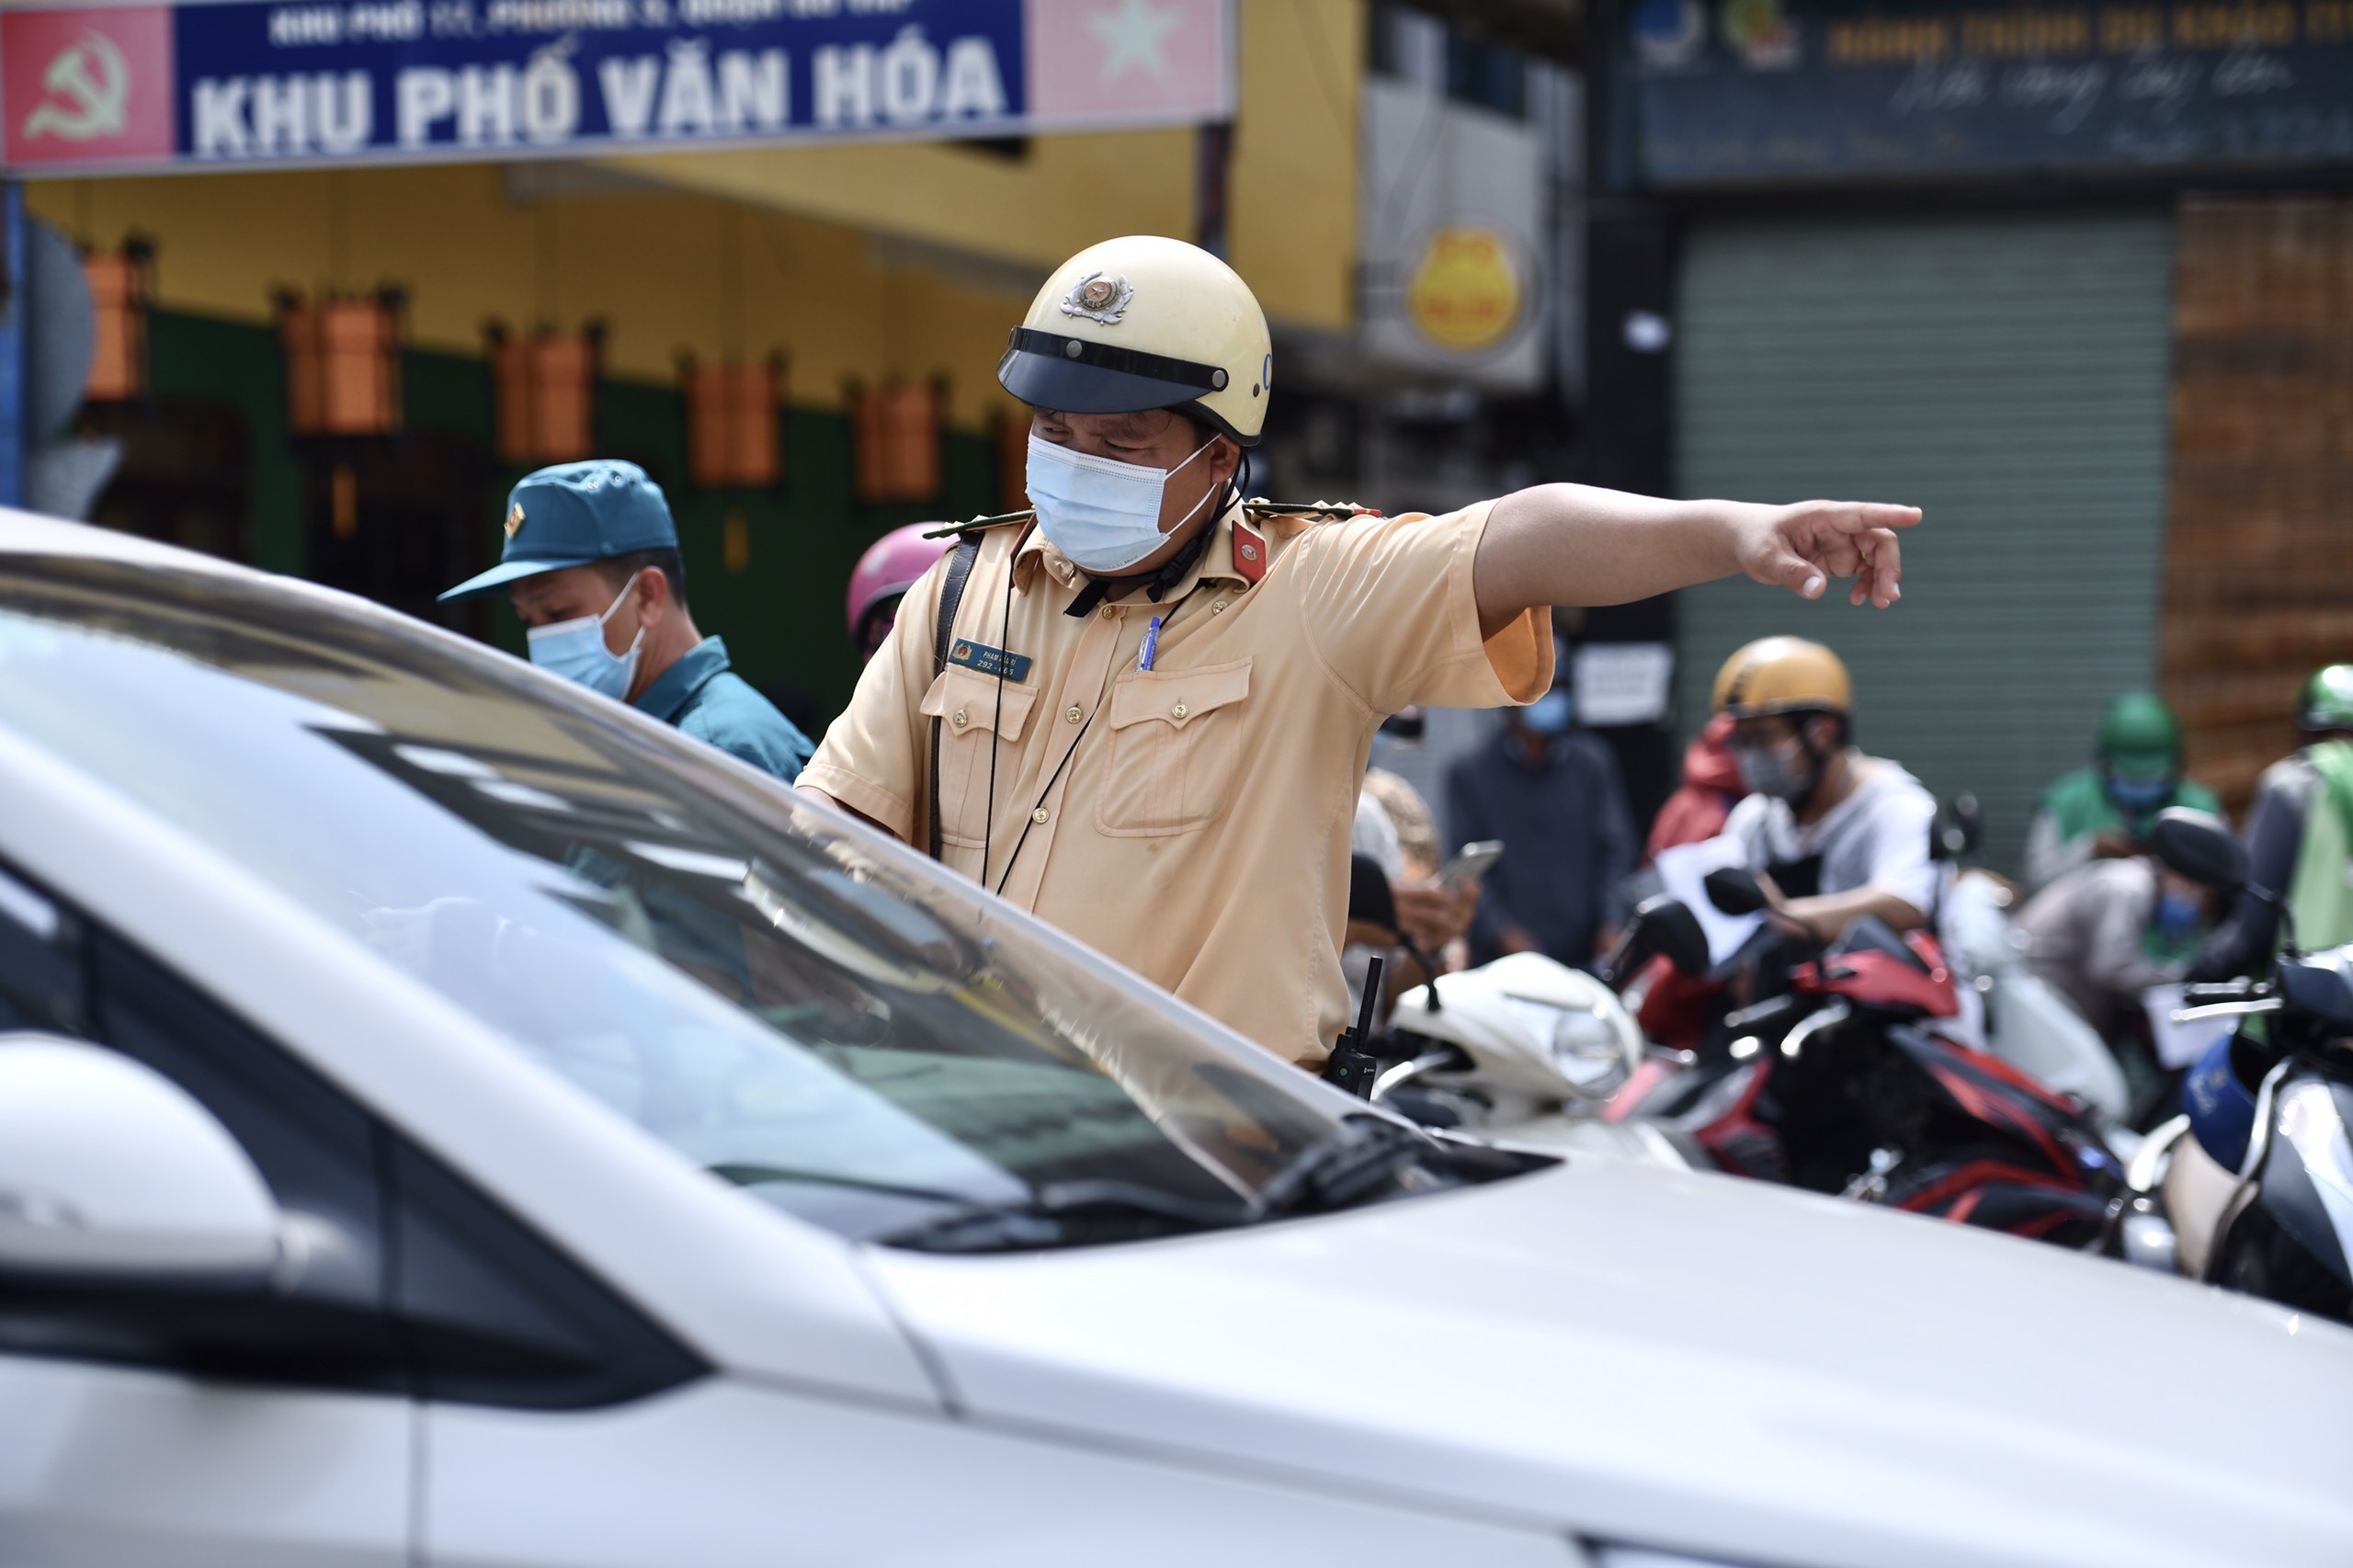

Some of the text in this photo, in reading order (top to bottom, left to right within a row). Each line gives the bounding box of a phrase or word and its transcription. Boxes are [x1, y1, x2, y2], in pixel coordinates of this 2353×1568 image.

[192, 25, 1007, 158] KHU PHỐ VĂN HÓA
